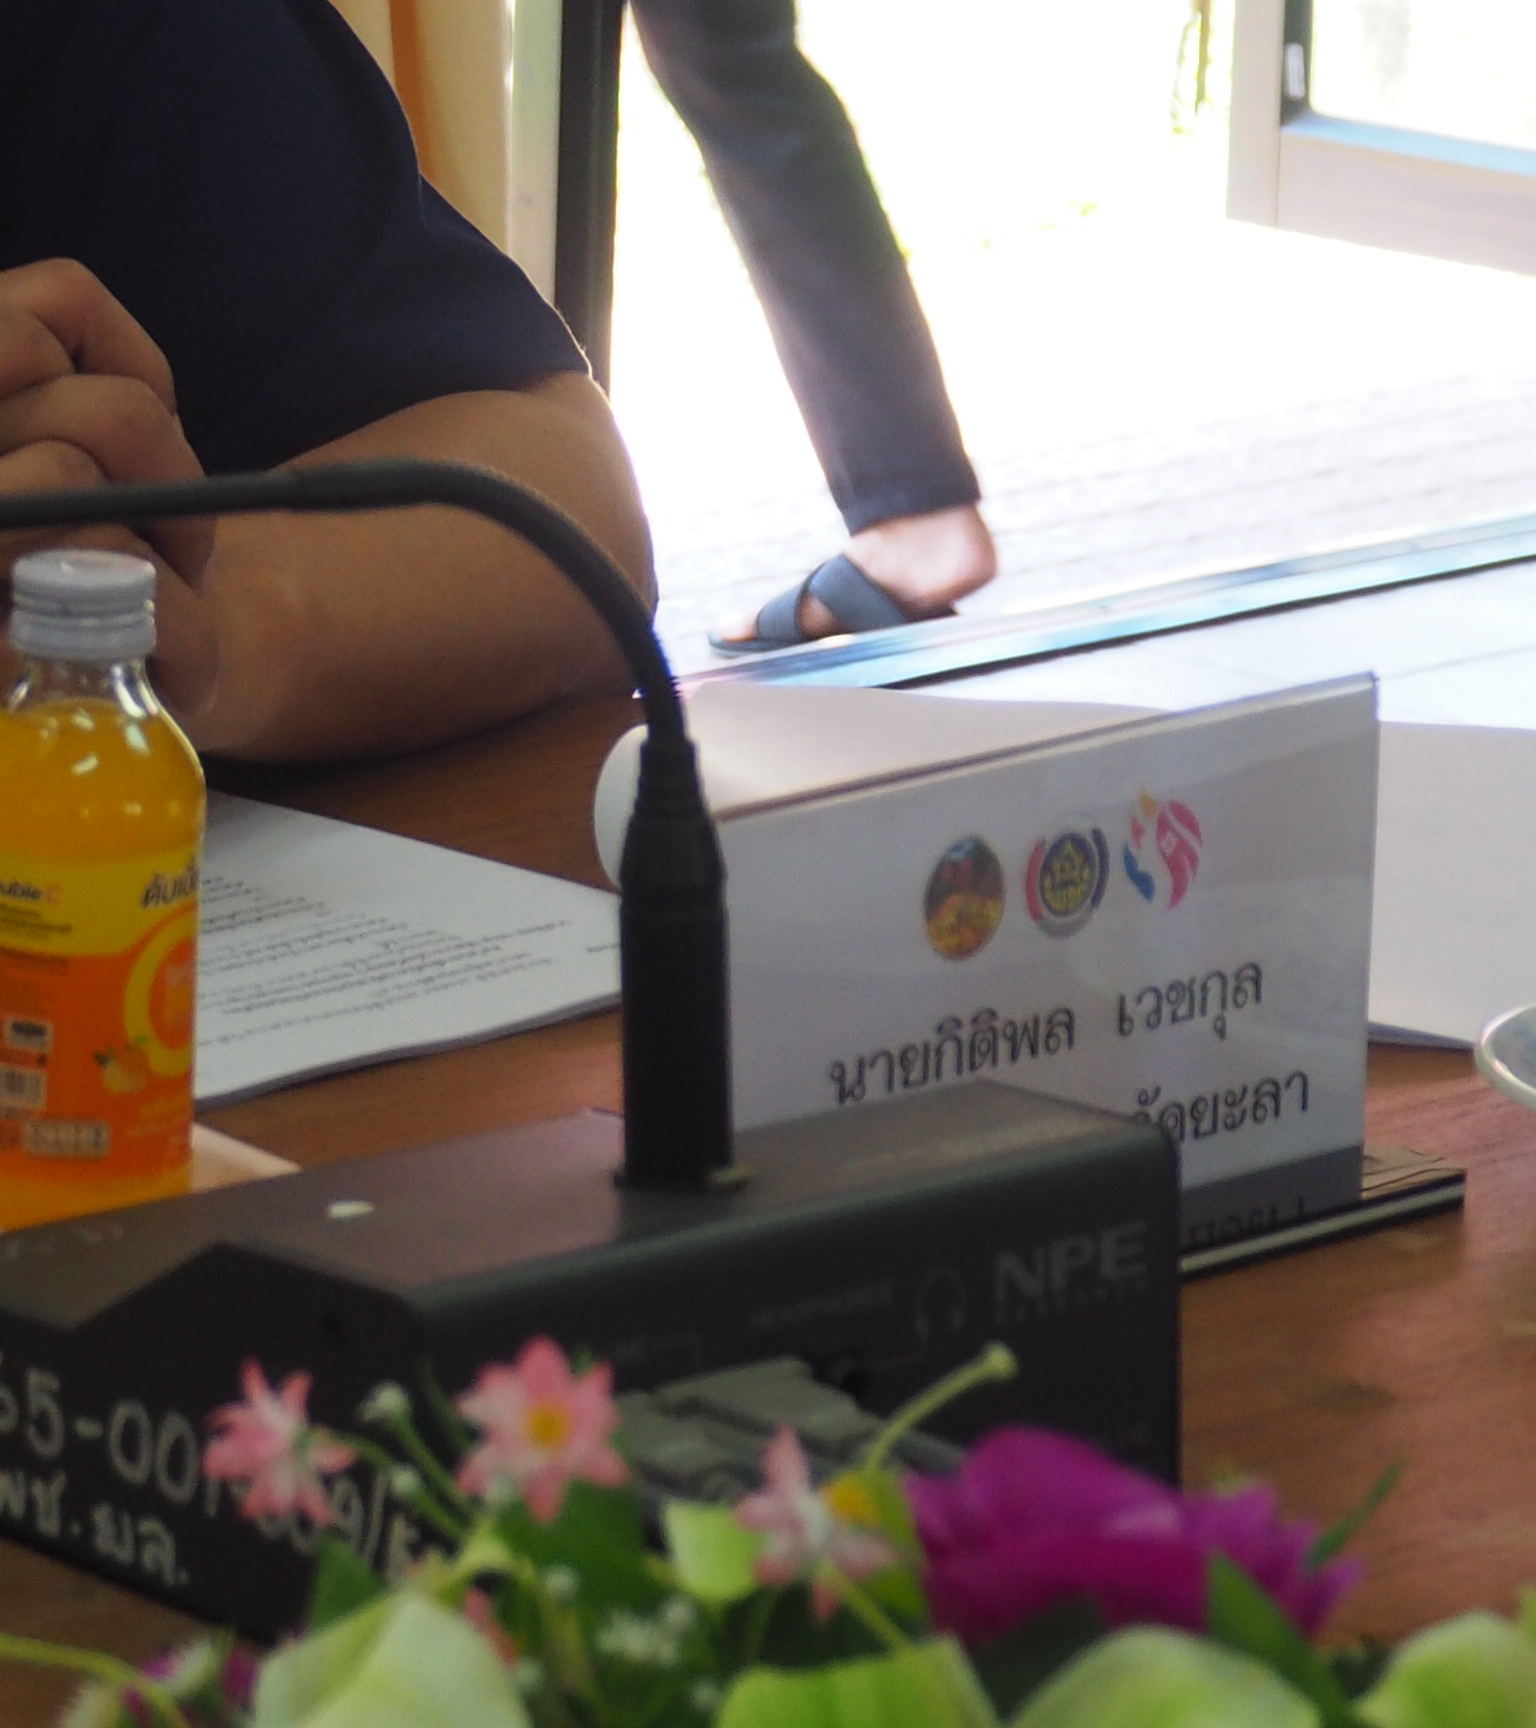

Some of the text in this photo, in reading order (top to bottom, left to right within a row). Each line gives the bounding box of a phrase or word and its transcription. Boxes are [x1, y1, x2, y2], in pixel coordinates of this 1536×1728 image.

[830, 958, 1264, 1104] นายกิติพล เวชกุล
[993, 1220, 1150, 1306] NPE
